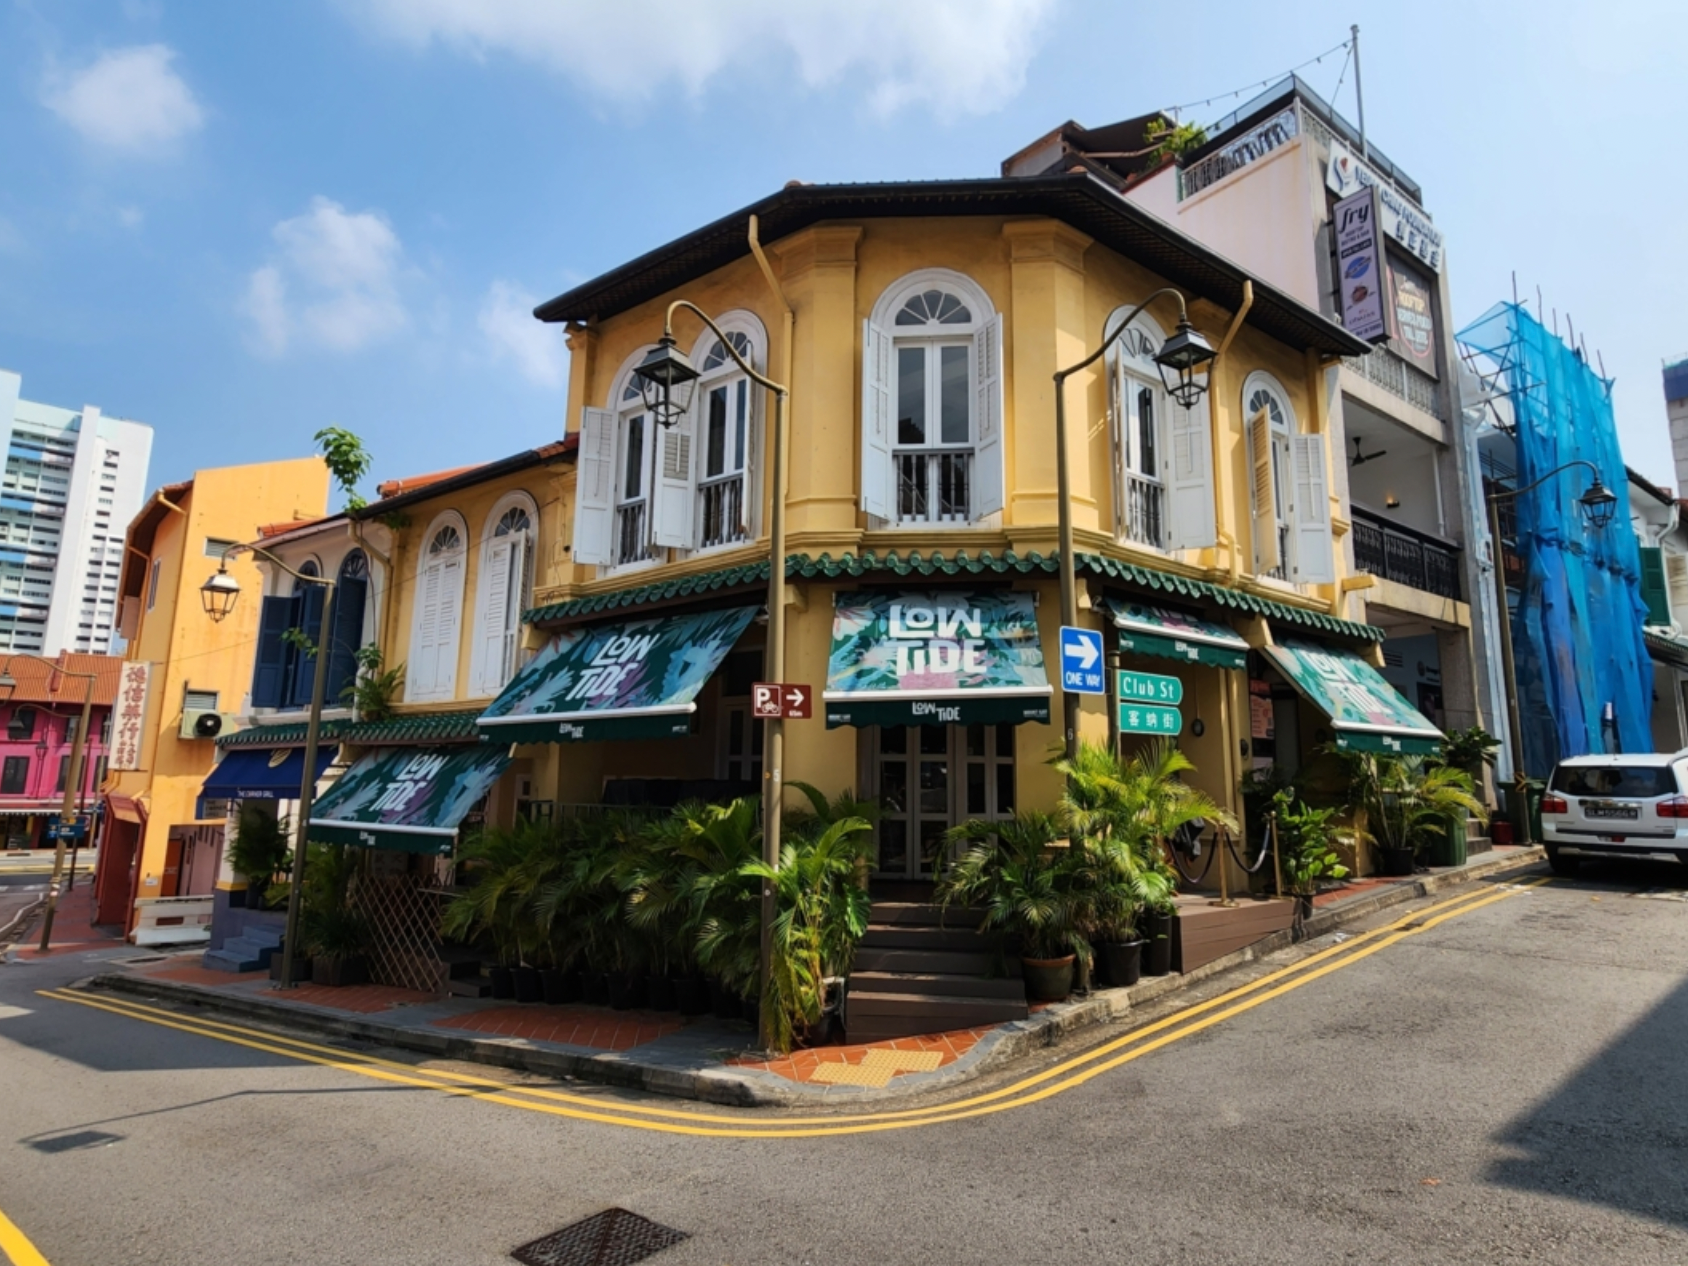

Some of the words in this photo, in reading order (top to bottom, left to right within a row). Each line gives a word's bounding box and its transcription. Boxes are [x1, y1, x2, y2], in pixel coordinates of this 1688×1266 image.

[890, 605, 981, 638] LOW
[590, 633, 661, 667] LOW
[1065, 670, 1083, 686] ONE
[1085, 674, 1101, 688] WAY
[1123, 676, 1155, 697] Club
[1160, 681, 1174, 699] St
[912, 701, 936, 715] LOW
